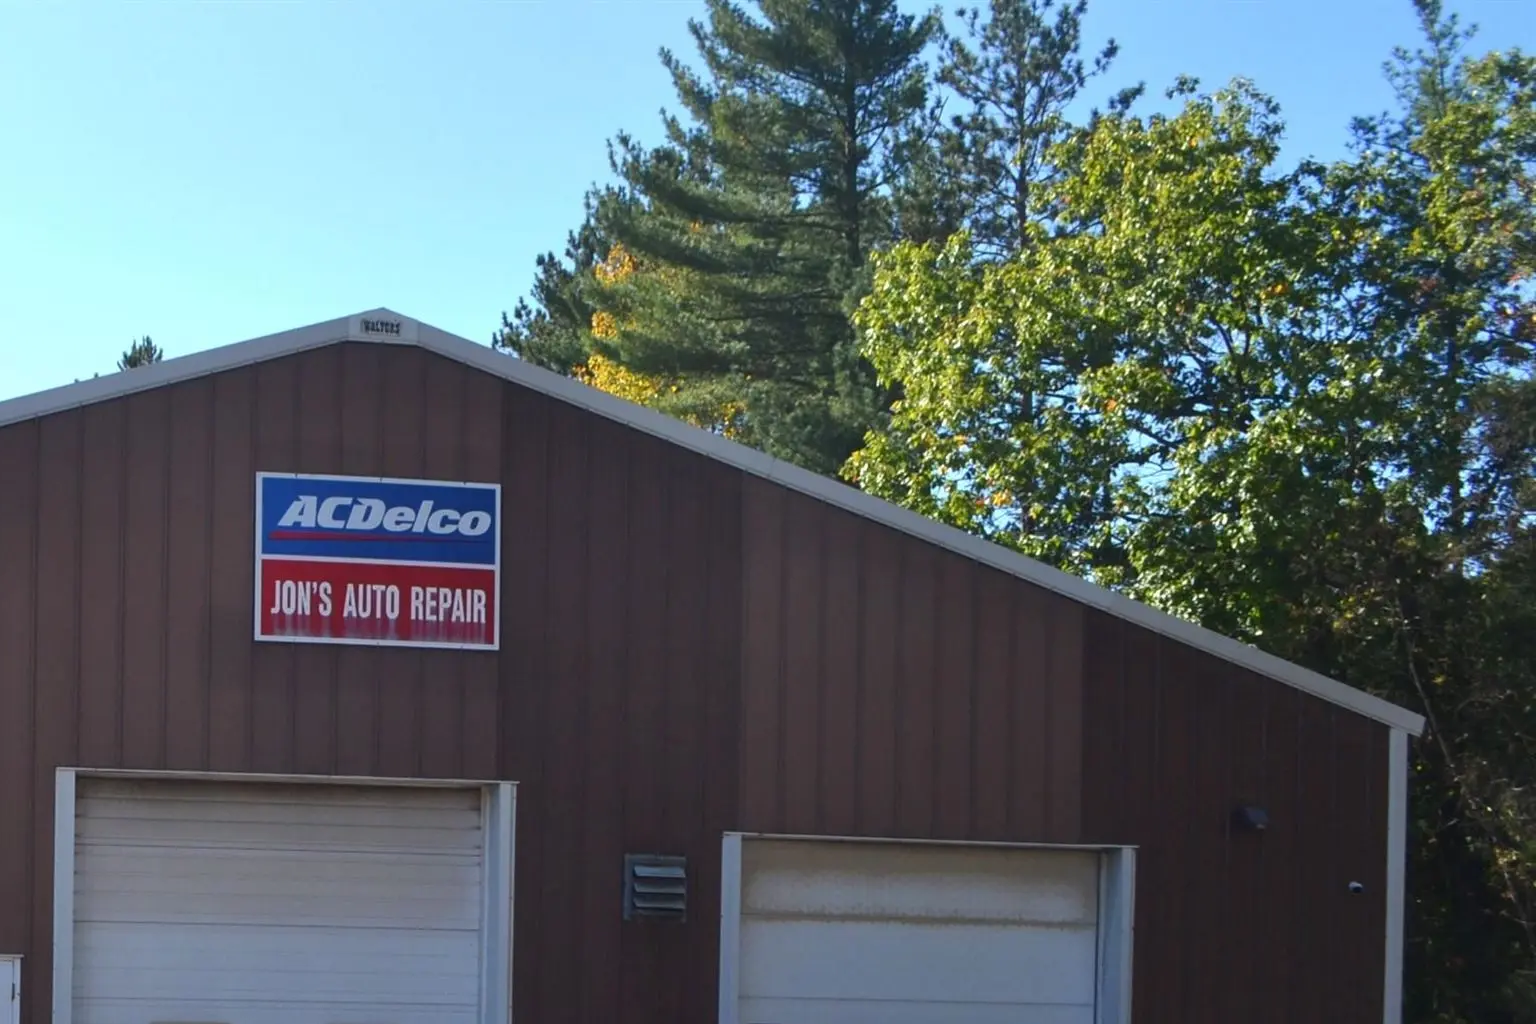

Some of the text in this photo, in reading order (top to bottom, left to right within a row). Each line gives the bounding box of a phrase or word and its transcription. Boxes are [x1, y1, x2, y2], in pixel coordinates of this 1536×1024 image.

[277, 495, 492, 537] ACDelco
[270, 579, 487, 624] JON'S AUTO REPAIR
